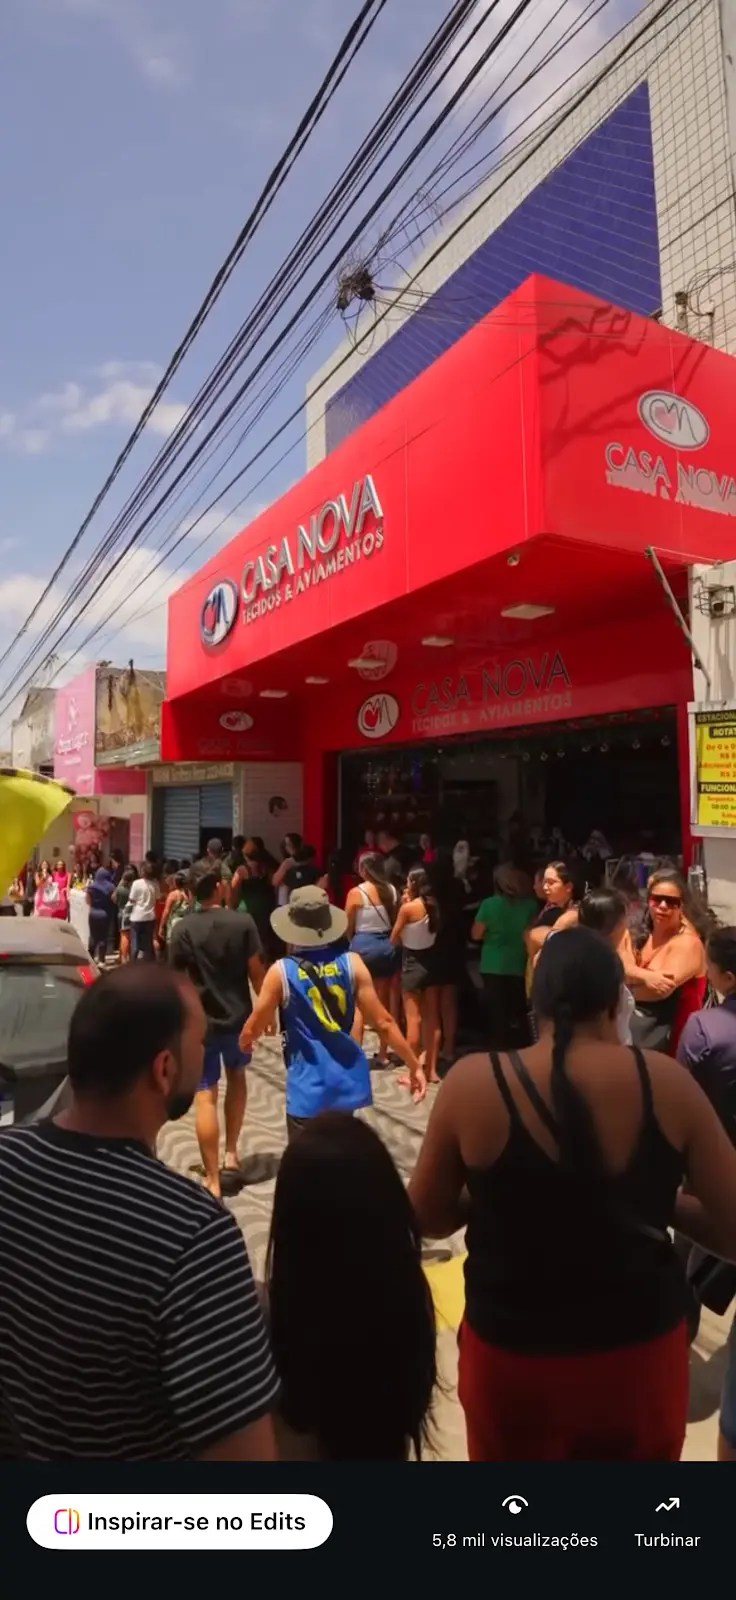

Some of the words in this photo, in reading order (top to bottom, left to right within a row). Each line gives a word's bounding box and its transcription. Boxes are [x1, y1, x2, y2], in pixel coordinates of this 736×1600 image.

[605, 442, 672, 489] CASA
[241, 535, 295, 604] CASA
[298, 474, 384, 569] NOVA
[243, 590, 281, 626] TECIDOS
[295, 526, 384, 596] AVIAMENTOS
[412, 676, 471, 716] CASA
[482, 650, 572, 702] NOVA
[412, 714, 456, 733] TECIDOS
[479, 691, 572, 724] AVIAMENTOS
[701, 783, 736, 793] FUNCION
